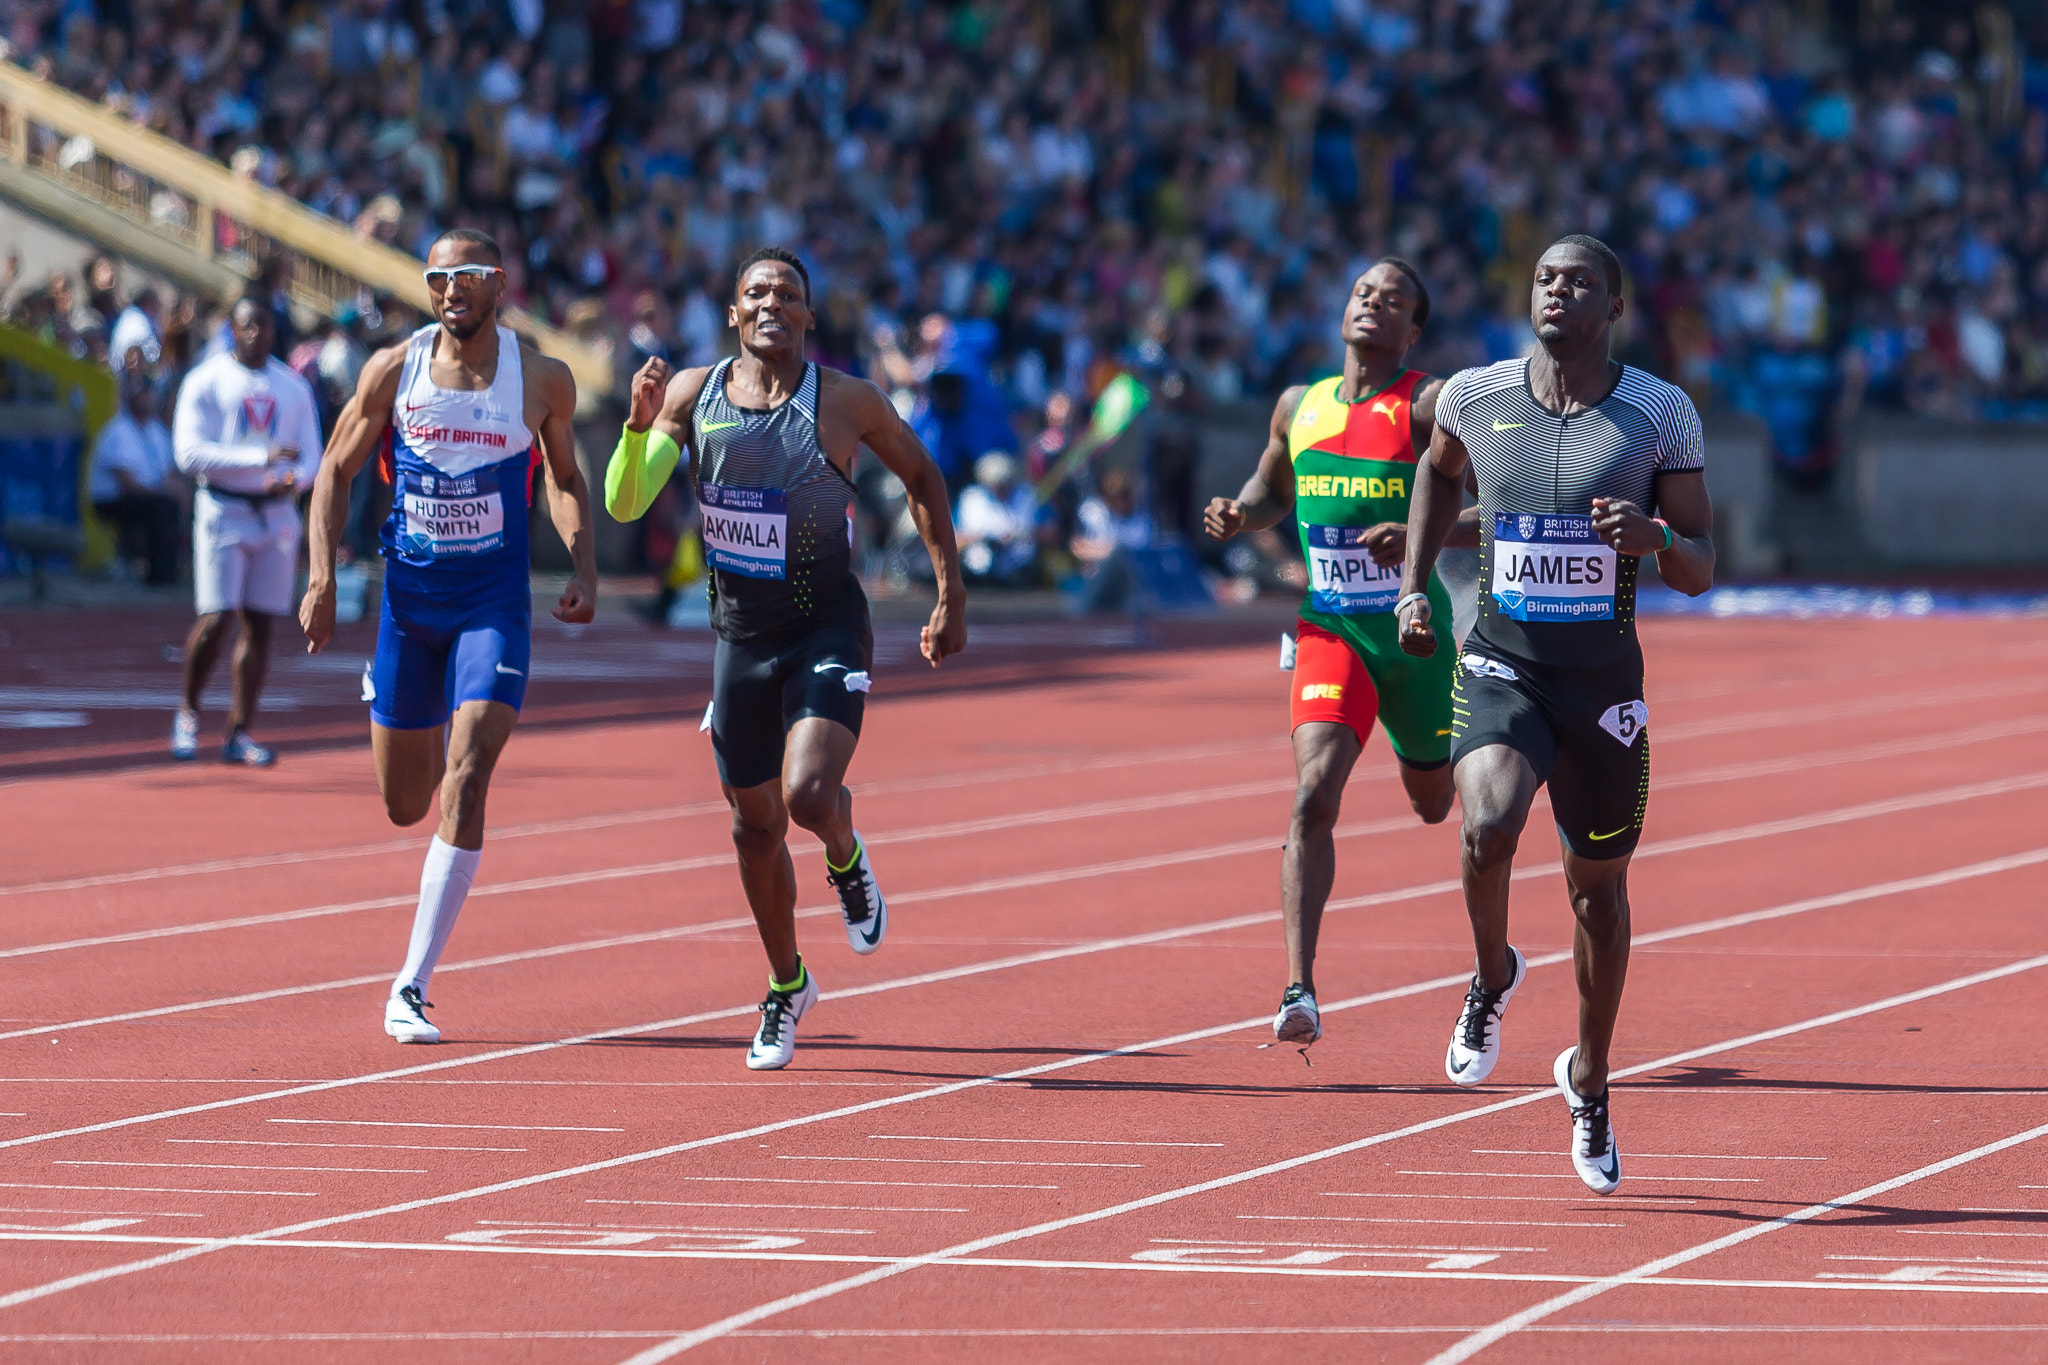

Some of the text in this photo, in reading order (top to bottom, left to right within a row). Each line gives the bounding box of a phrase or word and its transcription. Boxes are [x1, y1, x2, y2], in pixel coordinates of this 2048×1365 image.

[452, 429, 508, 449] BRITAIN
[439, 477, 476, 490] BRITISH
[1297, 475, 1405, 498] GRENADA
[723, 490, 763, 500] BRITISH
[723, 498, 763, 508] ATHLETICS
[415, 500, 489, 519] HUDSON
[425, 519, 480, 536] SMITH
[1544, 519, 1589, 530] BRITISH
[1542, 530, 1589, 538] ATHLETICS
[432, 536, 499, 554] Birmingham
[715, 552, 782, 573] Birmingham
[1505, 554, 1604, 585] JAMES
[1340, 594, 1399, 607] Birmingha
[1526, 601, 1610, 616] Birmingham
[1302, 683, 1343, 701] GRE
[1618, 703, 1637, 738] 5
